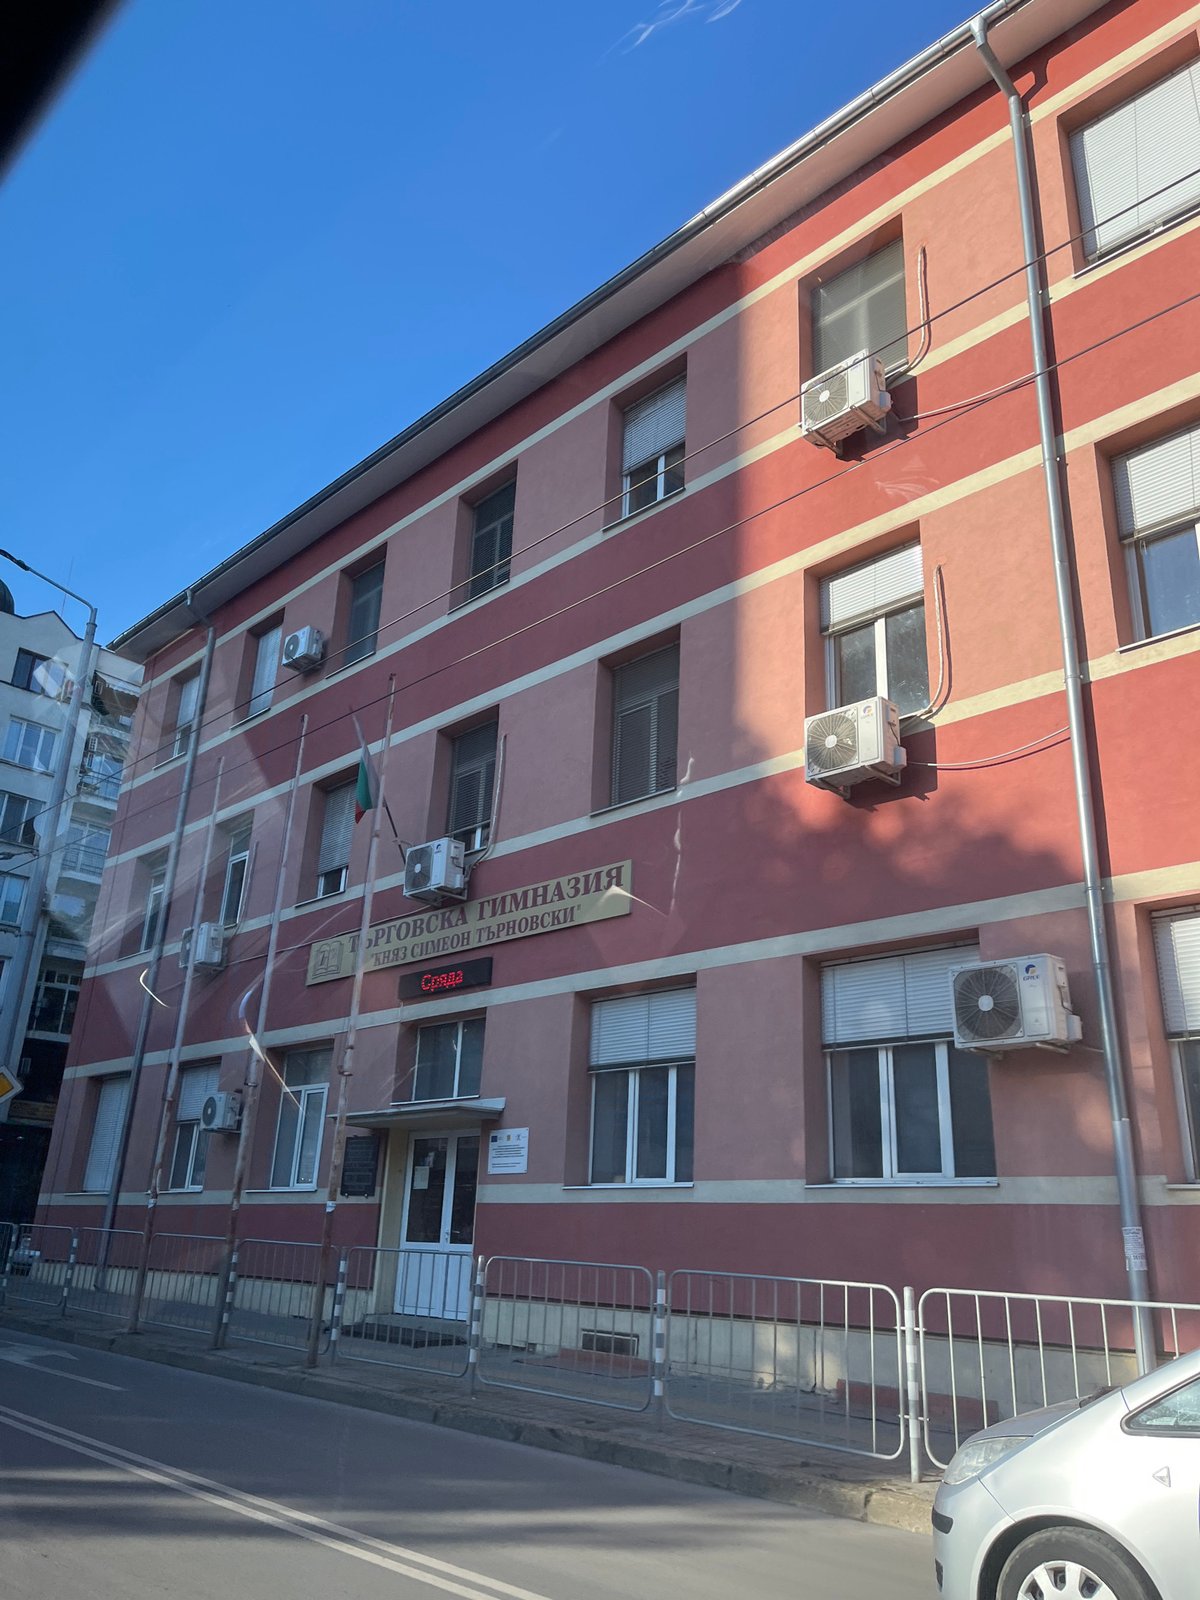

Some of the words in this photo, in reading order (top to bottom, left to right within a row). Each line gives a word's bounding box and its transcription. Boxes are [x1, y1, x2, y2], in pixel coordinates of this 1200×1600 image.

[478, 864, 625, 921] ГИМНАЗИЯ
[411, 931, 472, 958] СИМЕОН
[421, 969, 464, 992] Сряда
